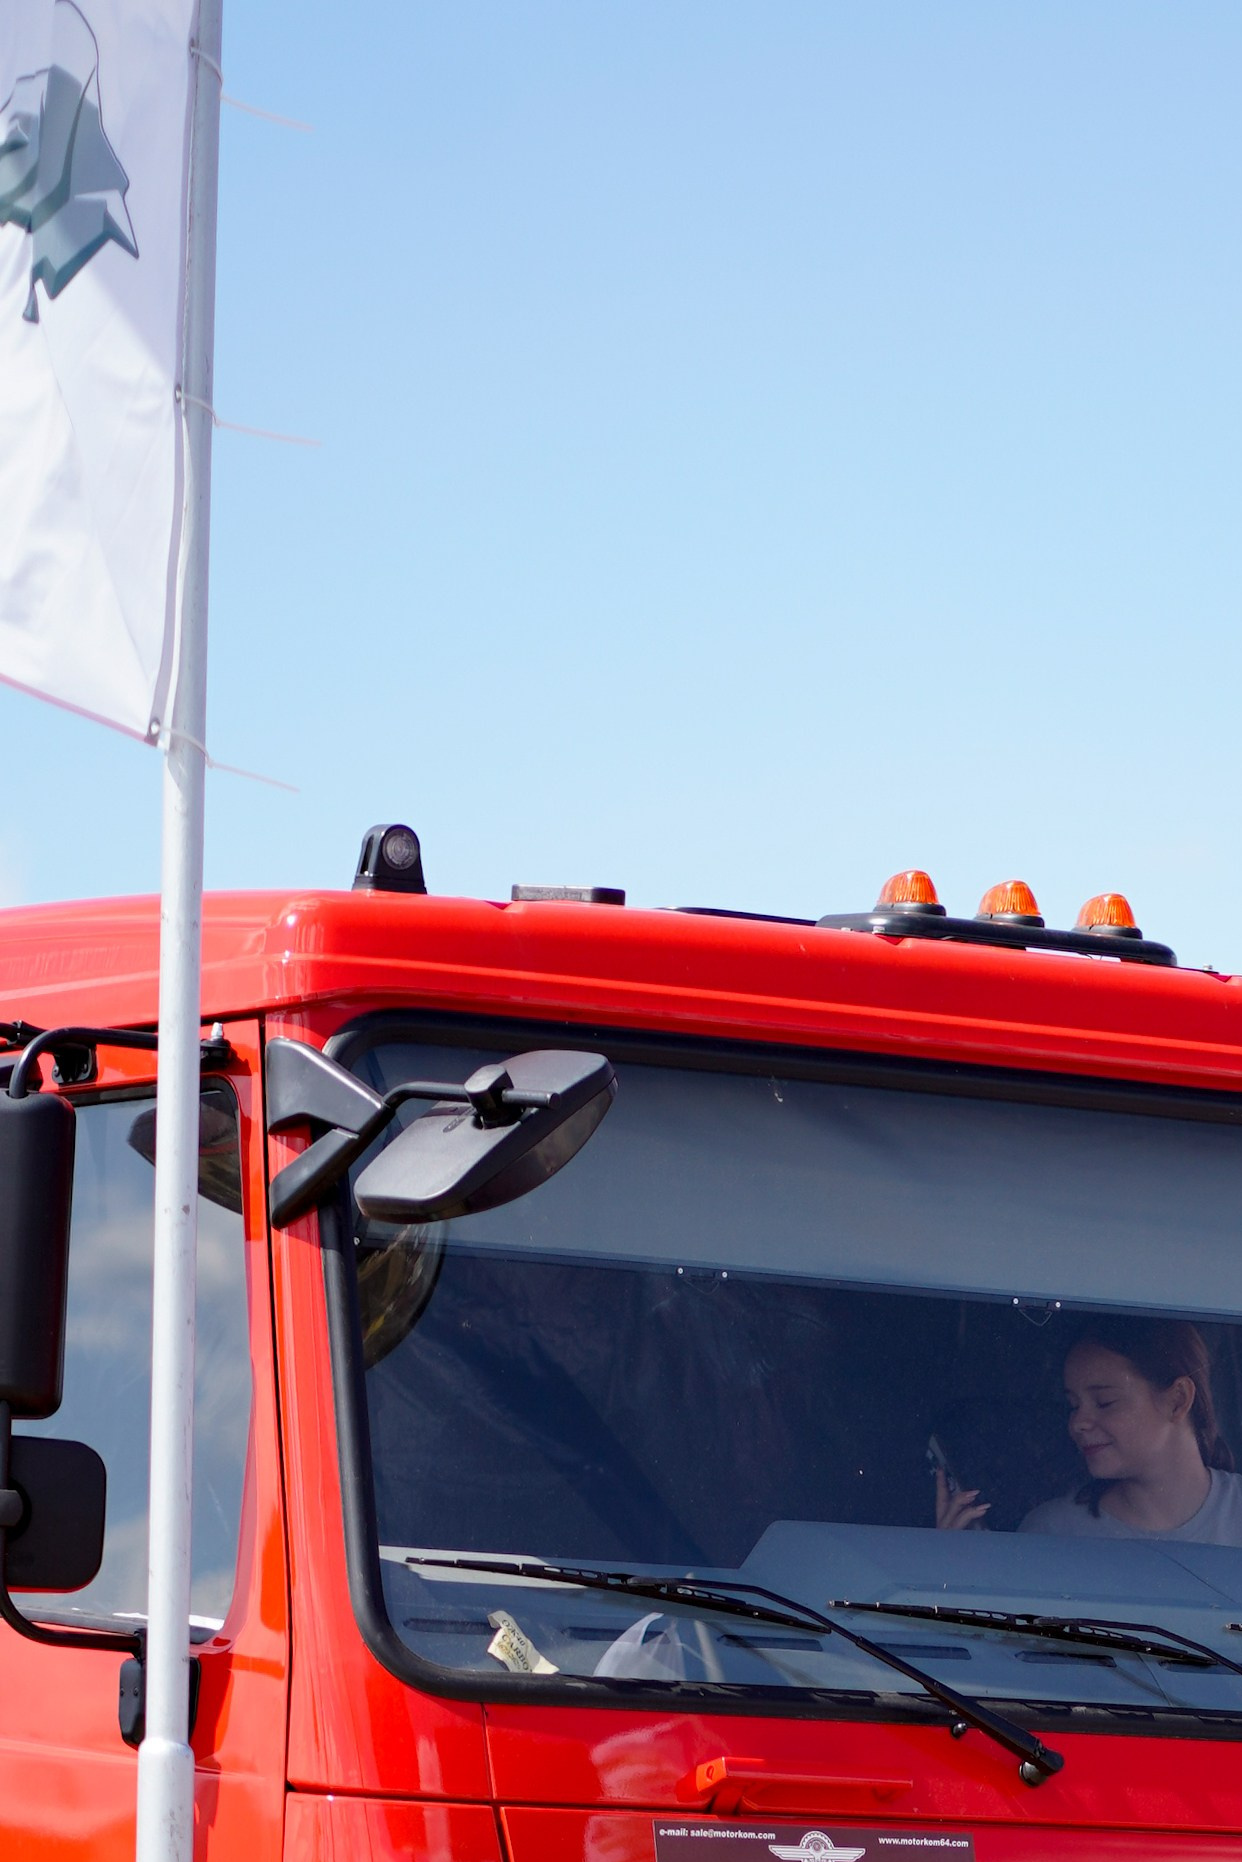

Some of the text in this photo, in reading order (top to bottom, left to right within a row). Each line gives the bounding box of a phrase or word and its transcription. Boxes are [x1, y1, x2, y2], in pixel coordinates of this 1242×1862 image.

[502, 1634, 532, 1672] CARBO
[659, 1828, 776, 1840] e-mail: sale@motorkom.com
[878, 1837, 969, 1848] www.motorkom64.com
